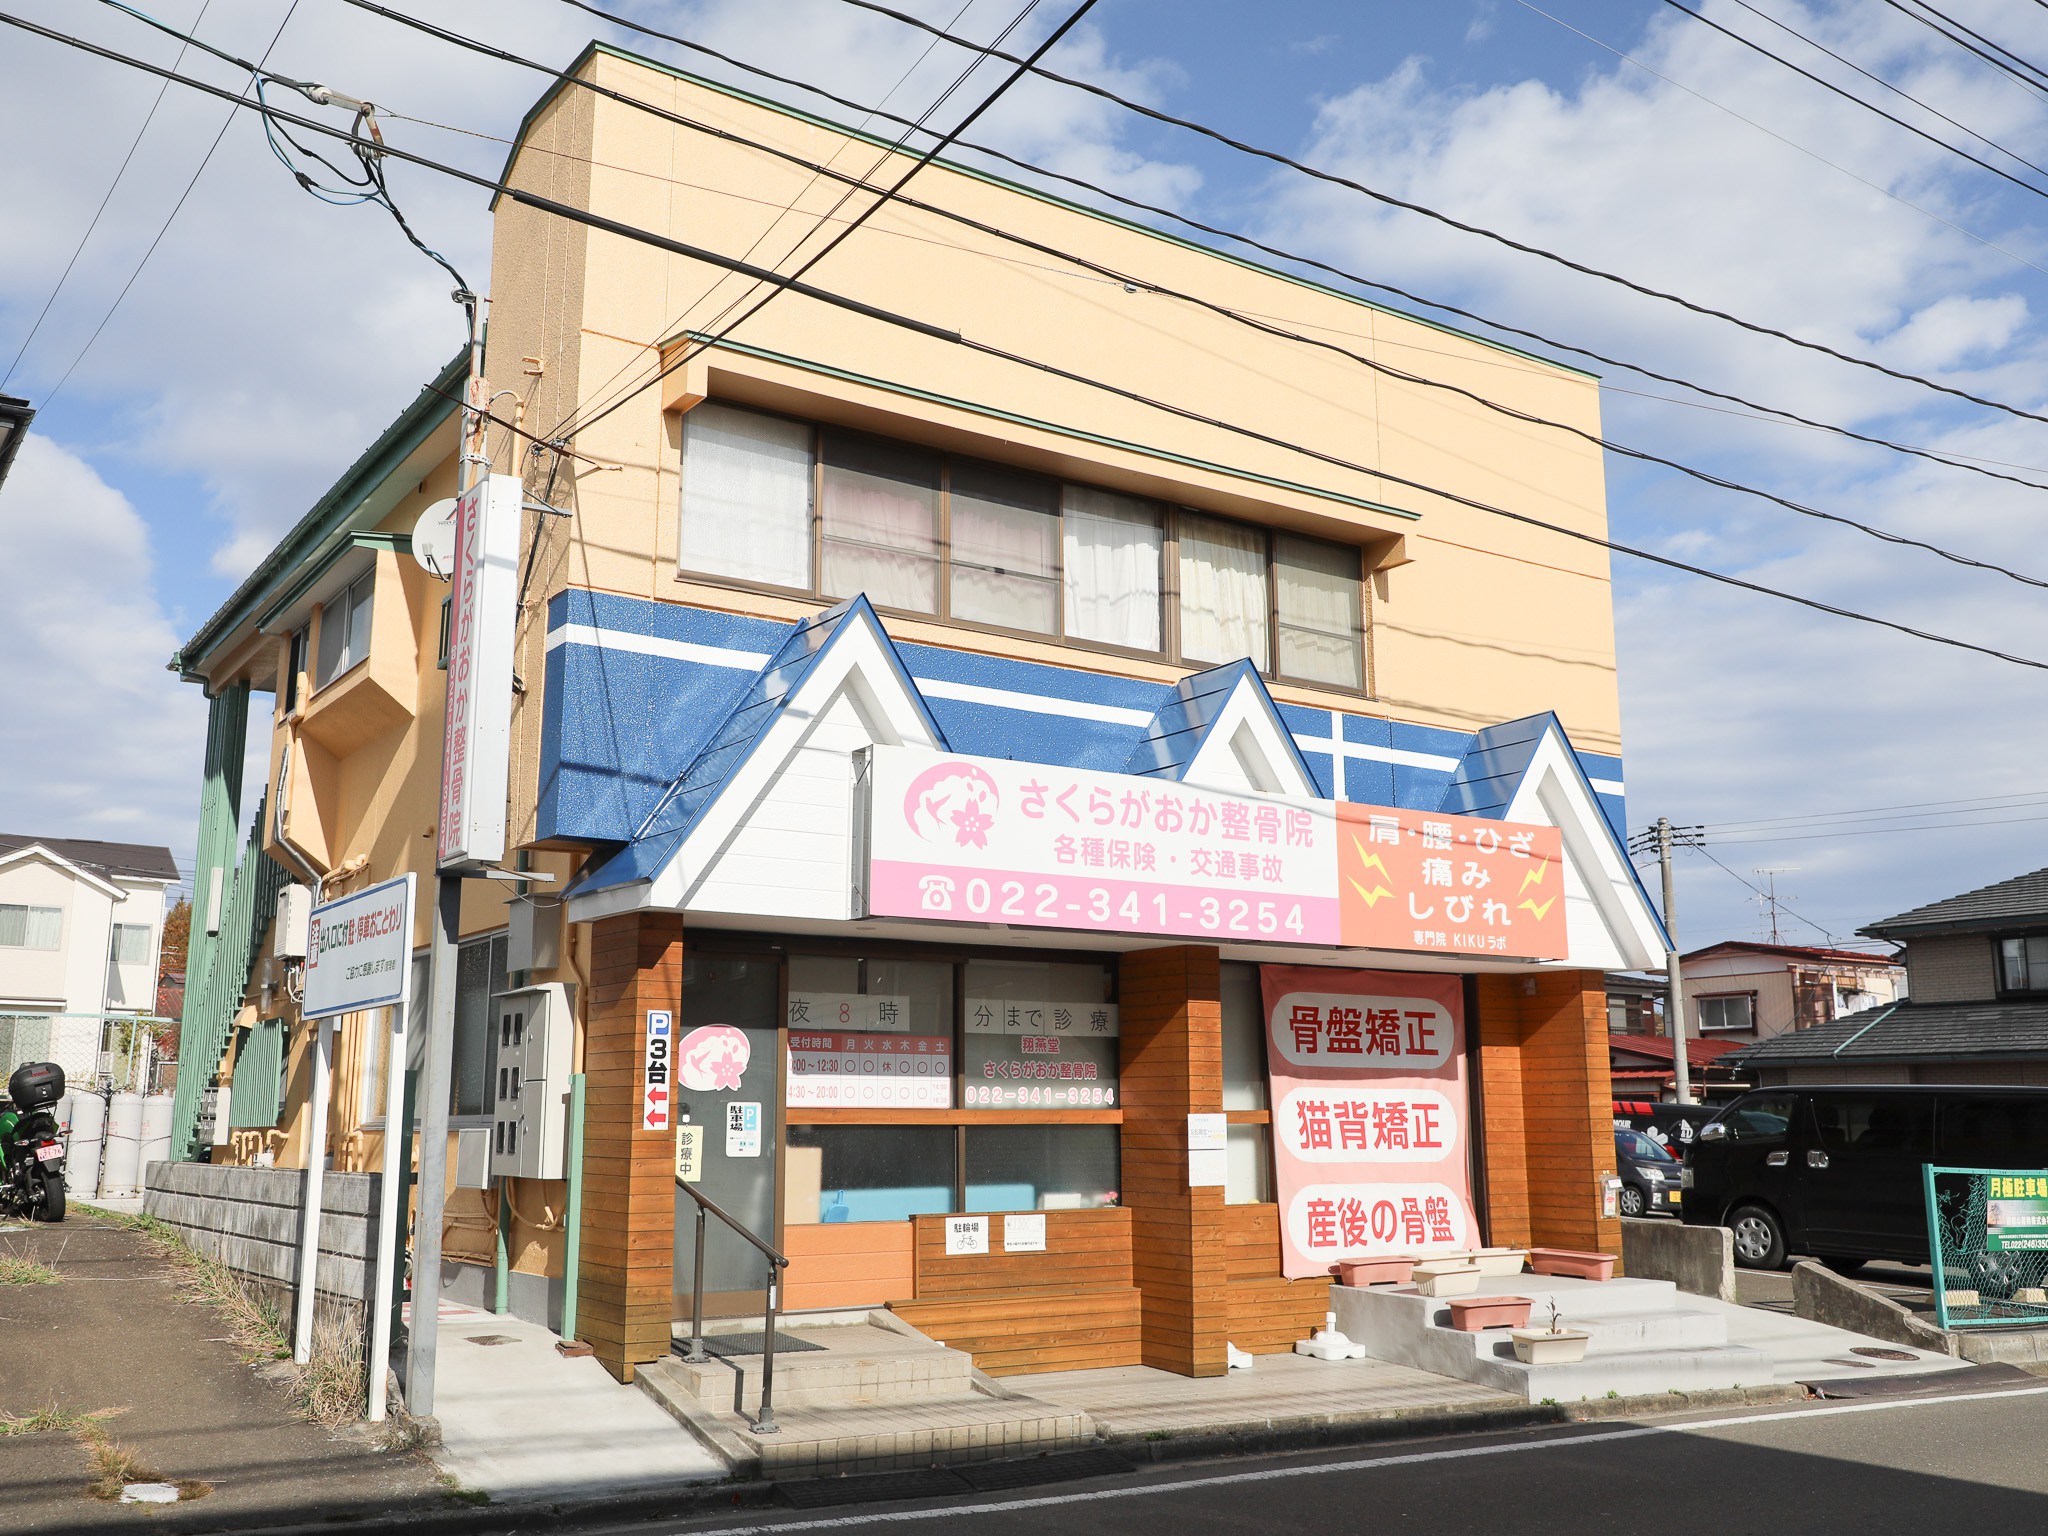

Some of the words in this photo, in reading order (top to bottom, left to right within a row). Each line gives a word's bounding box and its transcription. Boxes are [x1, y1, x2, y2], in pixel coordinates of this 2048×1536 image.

[448, 497, 479, 850] さくらがおか整骨院
[1019, 777, 1314, 848] さくらがおか整骨院
[1421, 856, 1492, 889] 痛み
[965, 878, 1305, 936] 022-341-3254
[1408, 891, 1512, 926] しびれ
[309, 921, 320, 966] 注意
[1413, 930, 1447, 947] 専門院
[789, 1037, 833, 1050] 受付時間
[846, 1039, 856, 1050] 月
[864, 1039, 874, 1050] 火
[882, 1040, 892, 1051] 水
[900, 1040, 910, 1051] 木
[918, 1041, 928, 1051] 金
[935, 1041, 945, 1052] 土
[1022, 1036, 1060, 1054] 翔燕堂
[1288, 1004, 1440, 1057] 骨盤矯正
[647, 1038, 668, 1085] 3台
[882, 1061, 892, 1072] 休
[983, 1061, 1098, 1080] さくらがおか整骨院
[965, 1086, 1115, 1105] 022-341-3254
[729, 1105, 744, 1132] 駐車場
[1296, 1100, 1443, 1150] 猫背矯正
[679, 1132, 694, 1175] 診療中
[1990, 1177, 2048, 1198] 月極駐車場
[953, 1222, 979, 1233] 駐輪場
[1306, 1195, 1456, 1248] 産後の骨盤
